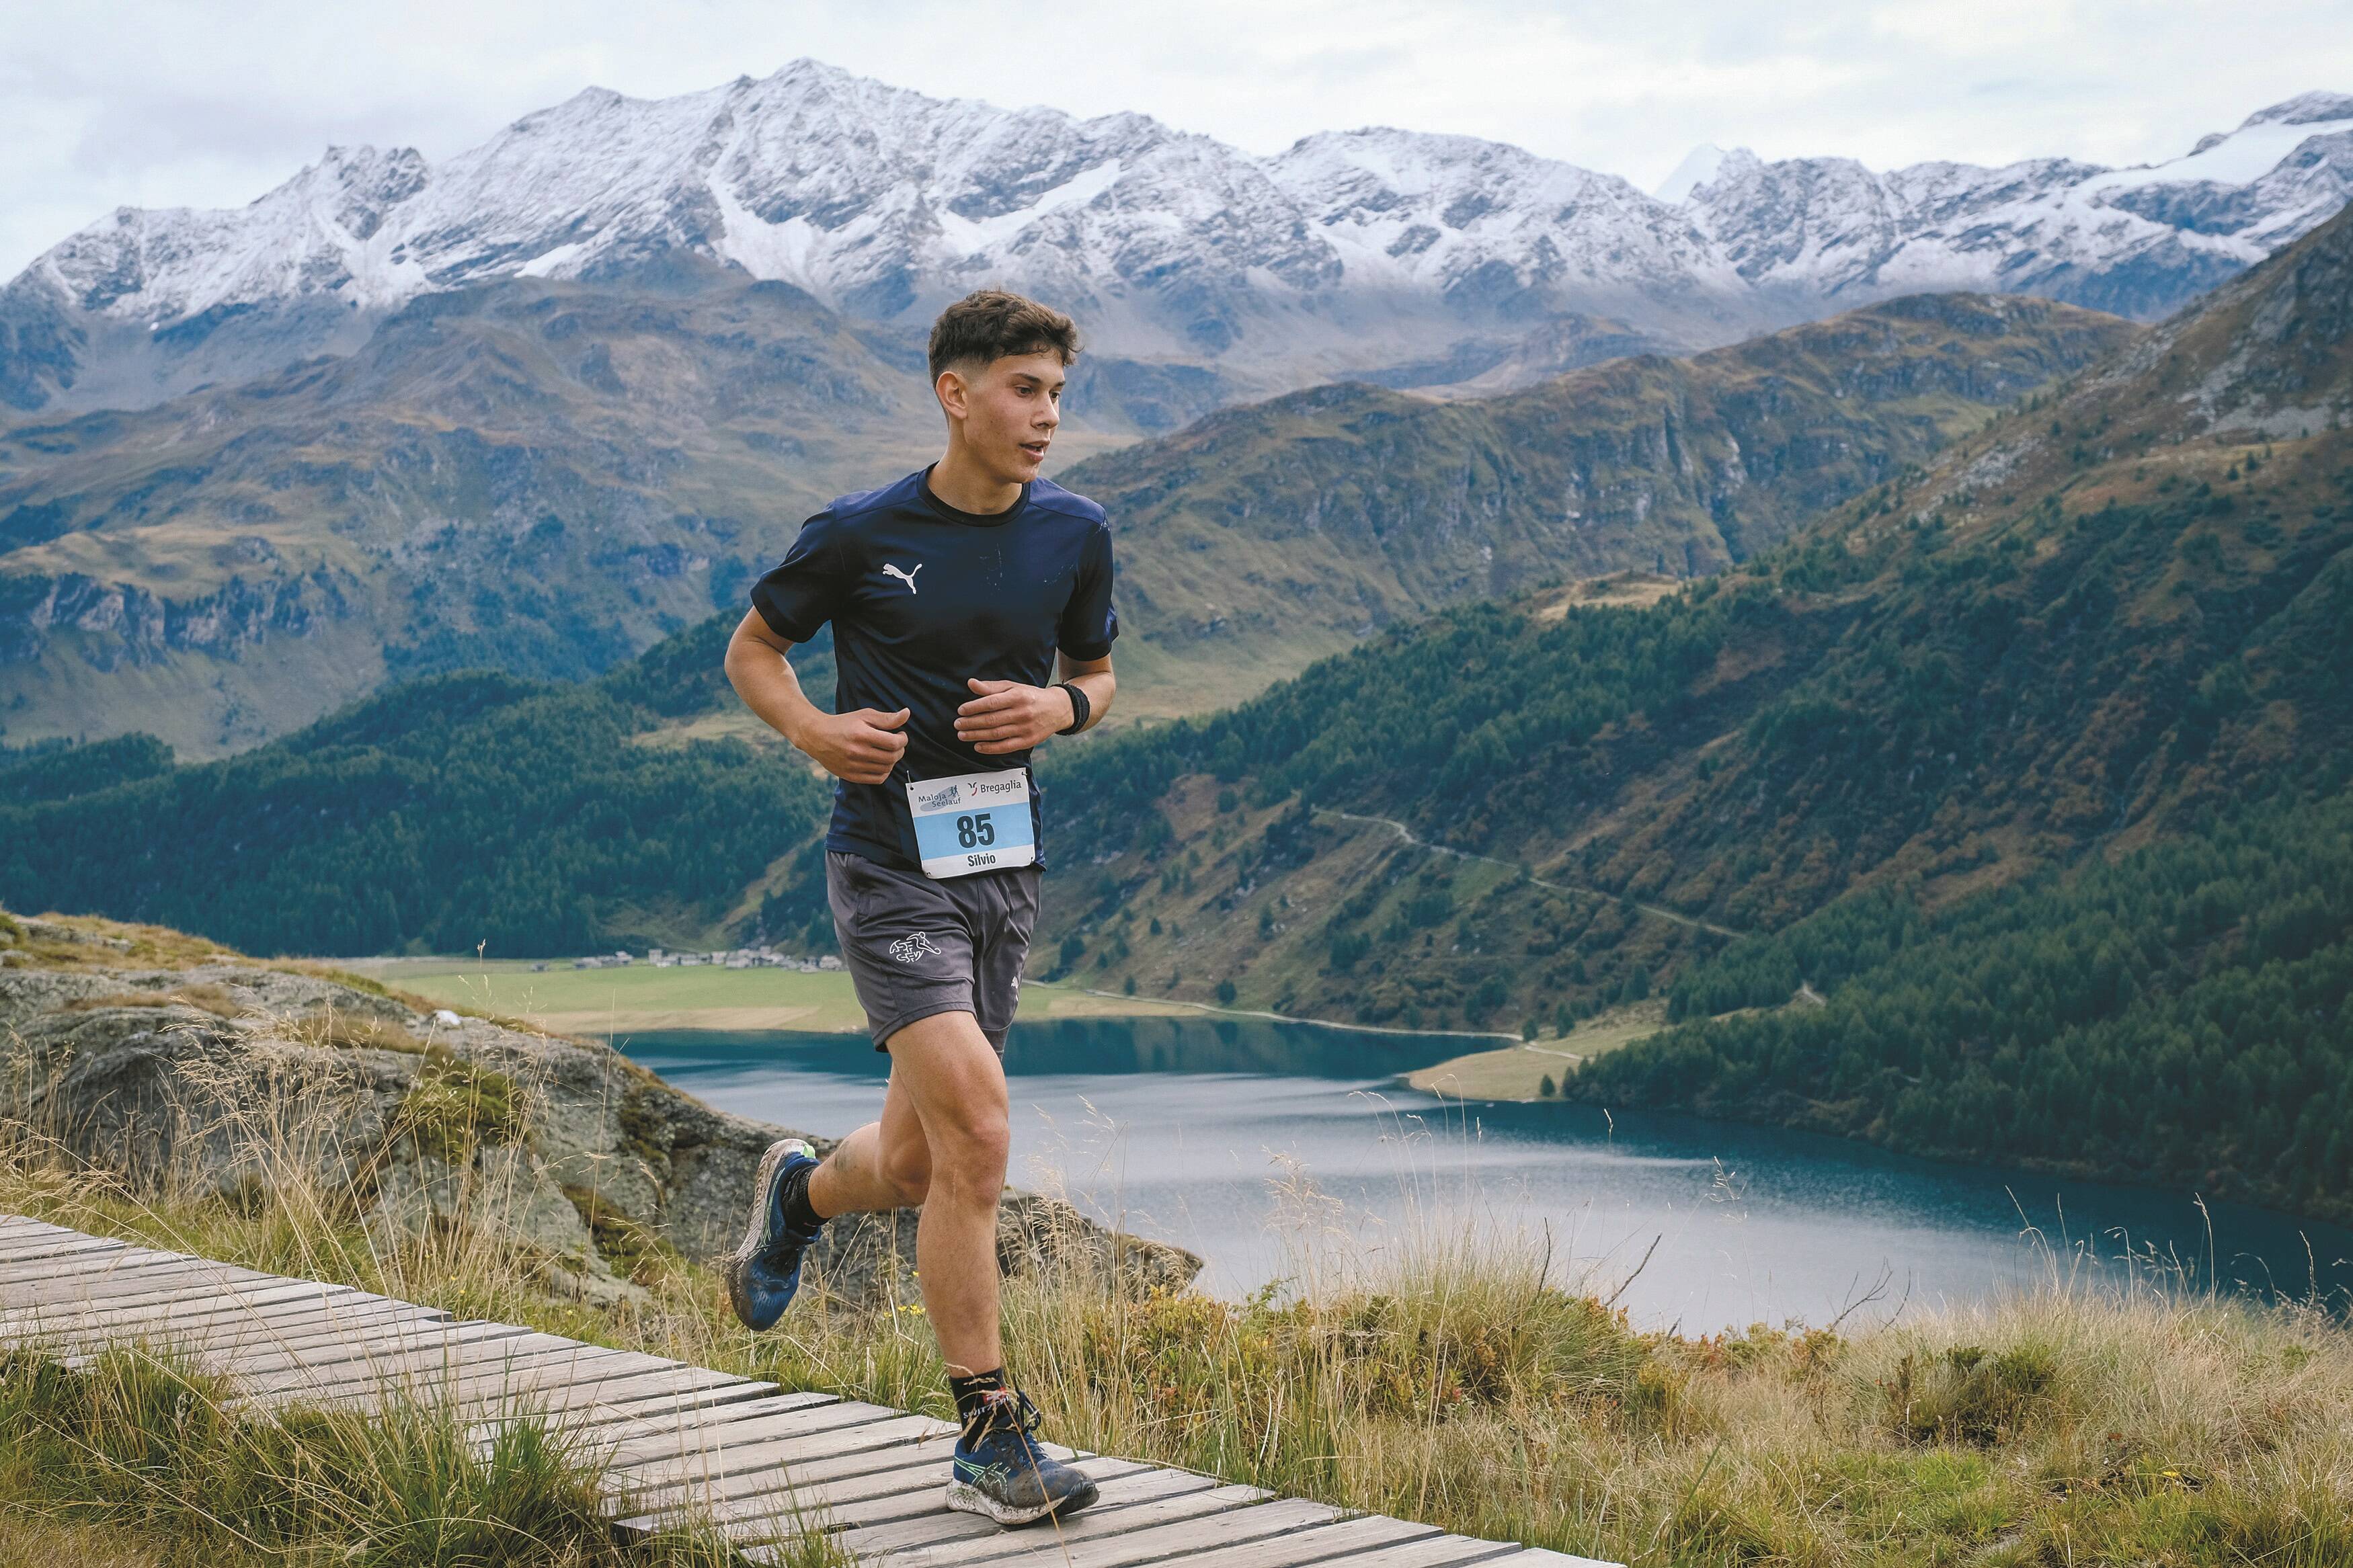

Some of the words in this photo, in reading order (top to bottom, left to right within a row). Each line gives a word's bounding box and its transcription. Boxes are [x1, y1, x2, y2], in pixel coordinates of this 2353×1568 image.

[980, 780, 1022, 794] Bregaglia
[918, 794, 947, 802] Maloja
[932, 797, 961, 807] Seelauf
[957, 813, 995, 848] 85
[967, 853, 996, 866] Silvio
